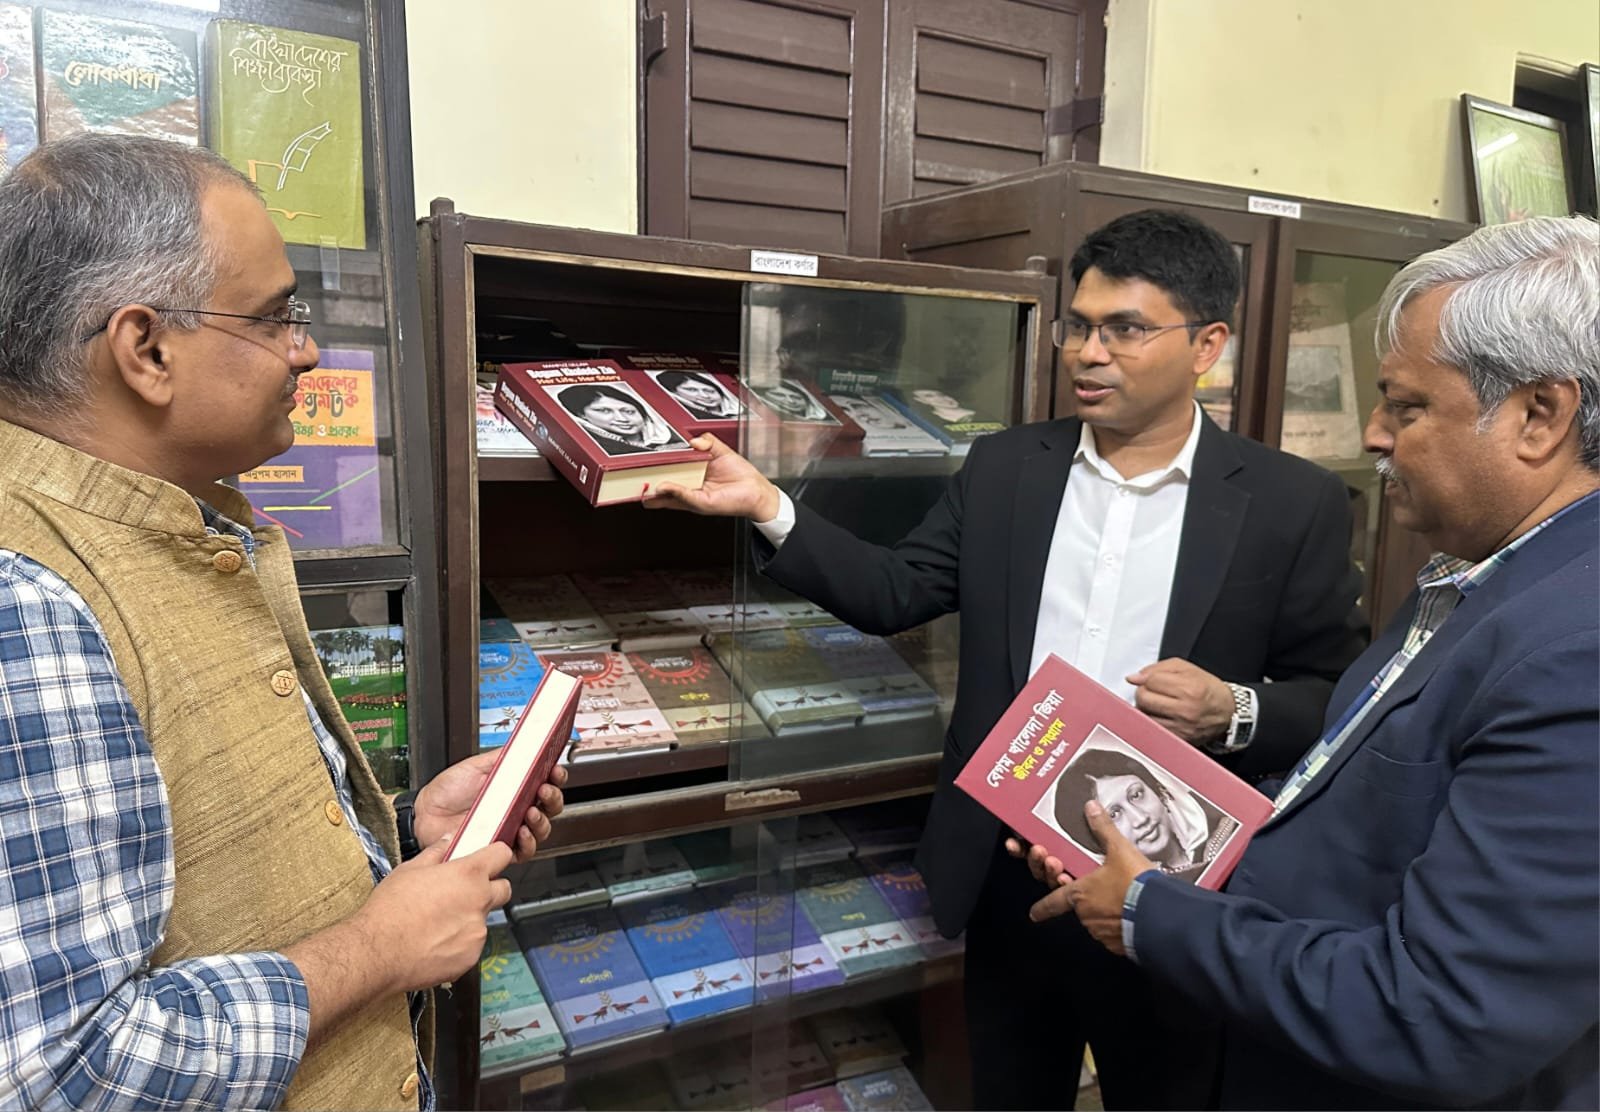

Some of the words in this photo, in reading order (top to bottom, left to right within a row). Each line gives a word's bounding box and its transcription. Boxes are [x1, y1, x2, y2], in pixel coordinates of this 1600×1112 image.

[249, 37, 348, 72] বাংলাদেশের
[297, 376, 358, 392] লাদেশের
[317, 424, 327, 436] ও
[273, 469, 297, 479] হাসান
[987, 753, 1016, 787] বেগম
[1008, 716, 1044, 754] খালেদা
[1033, 689, 1064, 720] জিয়া
[1012, 754, 1038, 780] জীবন
[1033, 746, 1045, 756] ও
